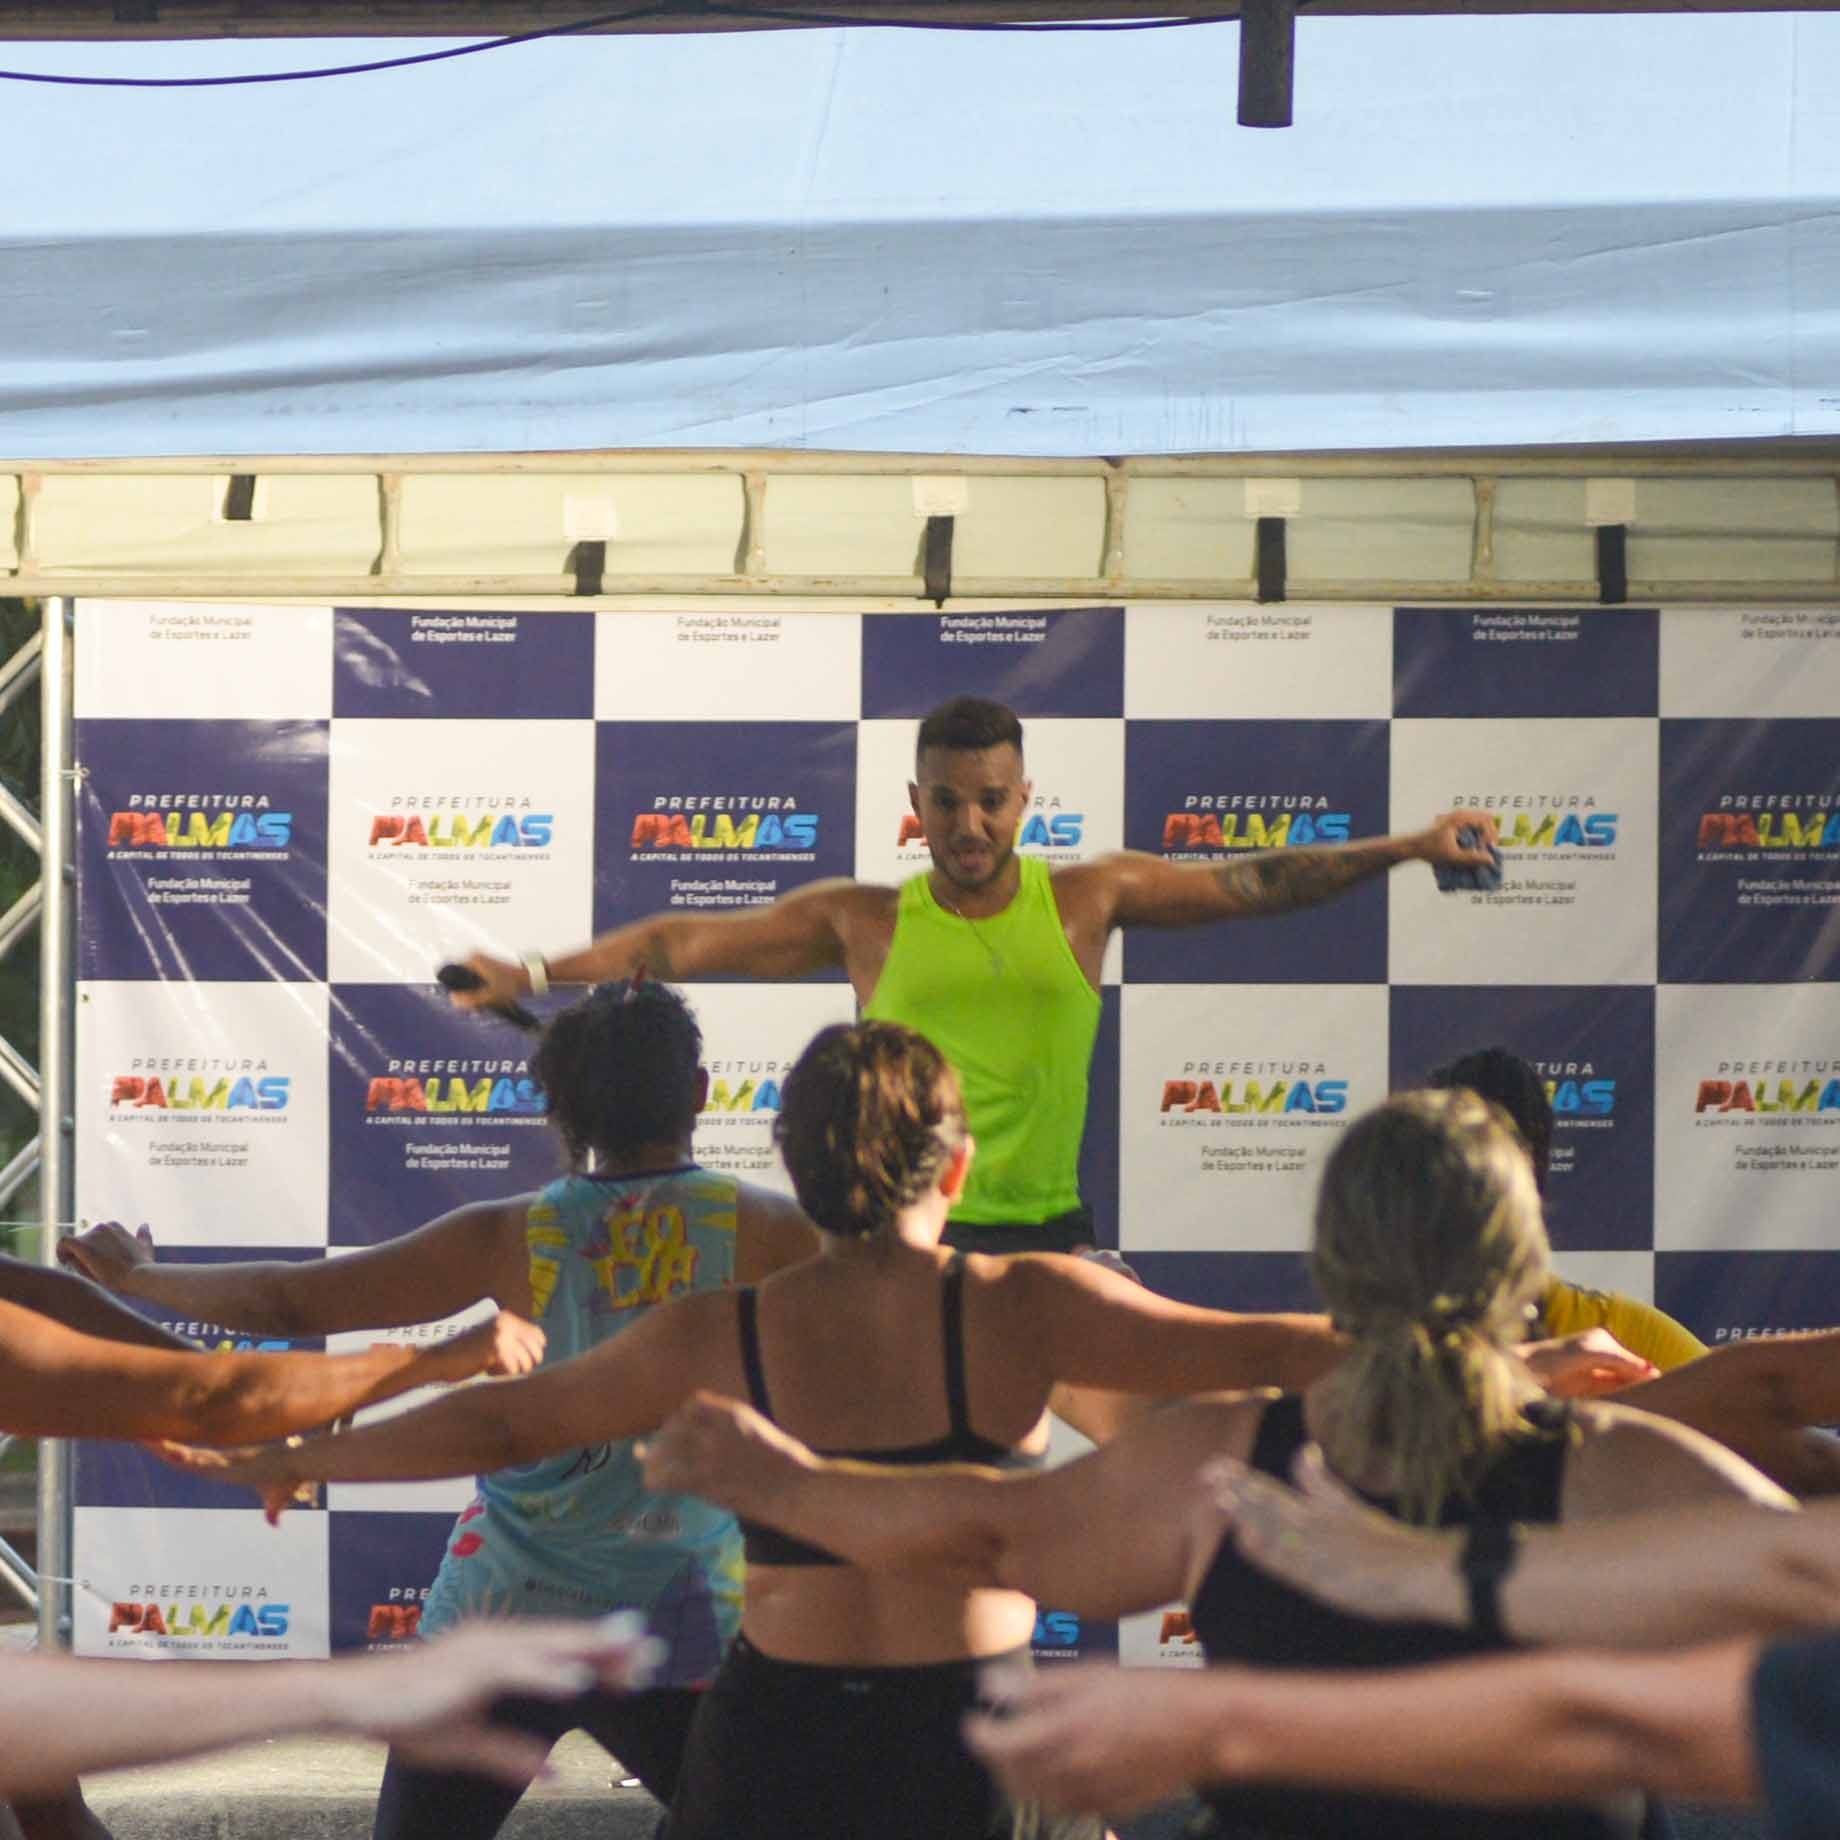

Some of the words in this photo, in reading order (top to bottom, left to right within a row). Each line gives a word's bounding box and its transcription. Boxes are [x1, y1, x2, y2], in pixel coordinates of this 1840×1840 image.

[466, 616, 517, 628] Municipal
[995, 616, 1047, 629] Municipal
[1528, 614, 1579, 627] Municipal
[129, 794, 270, 808] PREFEITURA
[391, 796, 531, 808] PREFEITURA
[654, 796, 797, 810] PREFEITURA
[1184, 795, 1329, 809] PREFEITURA
[1453, 795, 1596, 808] PREFEITURA
[108, 811, 292, 847] PALMAS
[369, 814, 554, 847] PALMAS
[631, 813, 819, 848] PALMAS
[1162, 812, 1351, 848] PALMAS
[201, 878, 250, 890] Municipal
[725, 880, 776, 892] Municipal
[670, 894, 683, 904] de
[686, 894, 733, 906] Esportes
[744, 894, 776, 904] Lazer
[131, 1058, 268, 1071] PREFEITURA
[388, 1059, 529, 1073] PREFEITURA
[1184, 1062, 1326, 1074] PREFEITURA
[111, 1076, 290, 1110] PALMAS
[367, 1076, 547, 1112] PALMAS
[1161, 1079, 1348, 1114] PALMAS
[459, 1143, 510, 1156] Municipal
[1255, 1146, 1306, 1158] Municipal
[1789, 1145, 1839, 1158] Municipal
[405, 1158, 418, 1168] de
[421, 1158, 467, 1170] Esportes
[479, 1158, 510, 1168] Lazer
[130, 1584, 268, 1598] PREFEITURA
[108, 1602, 289, 1636] PALMAS
